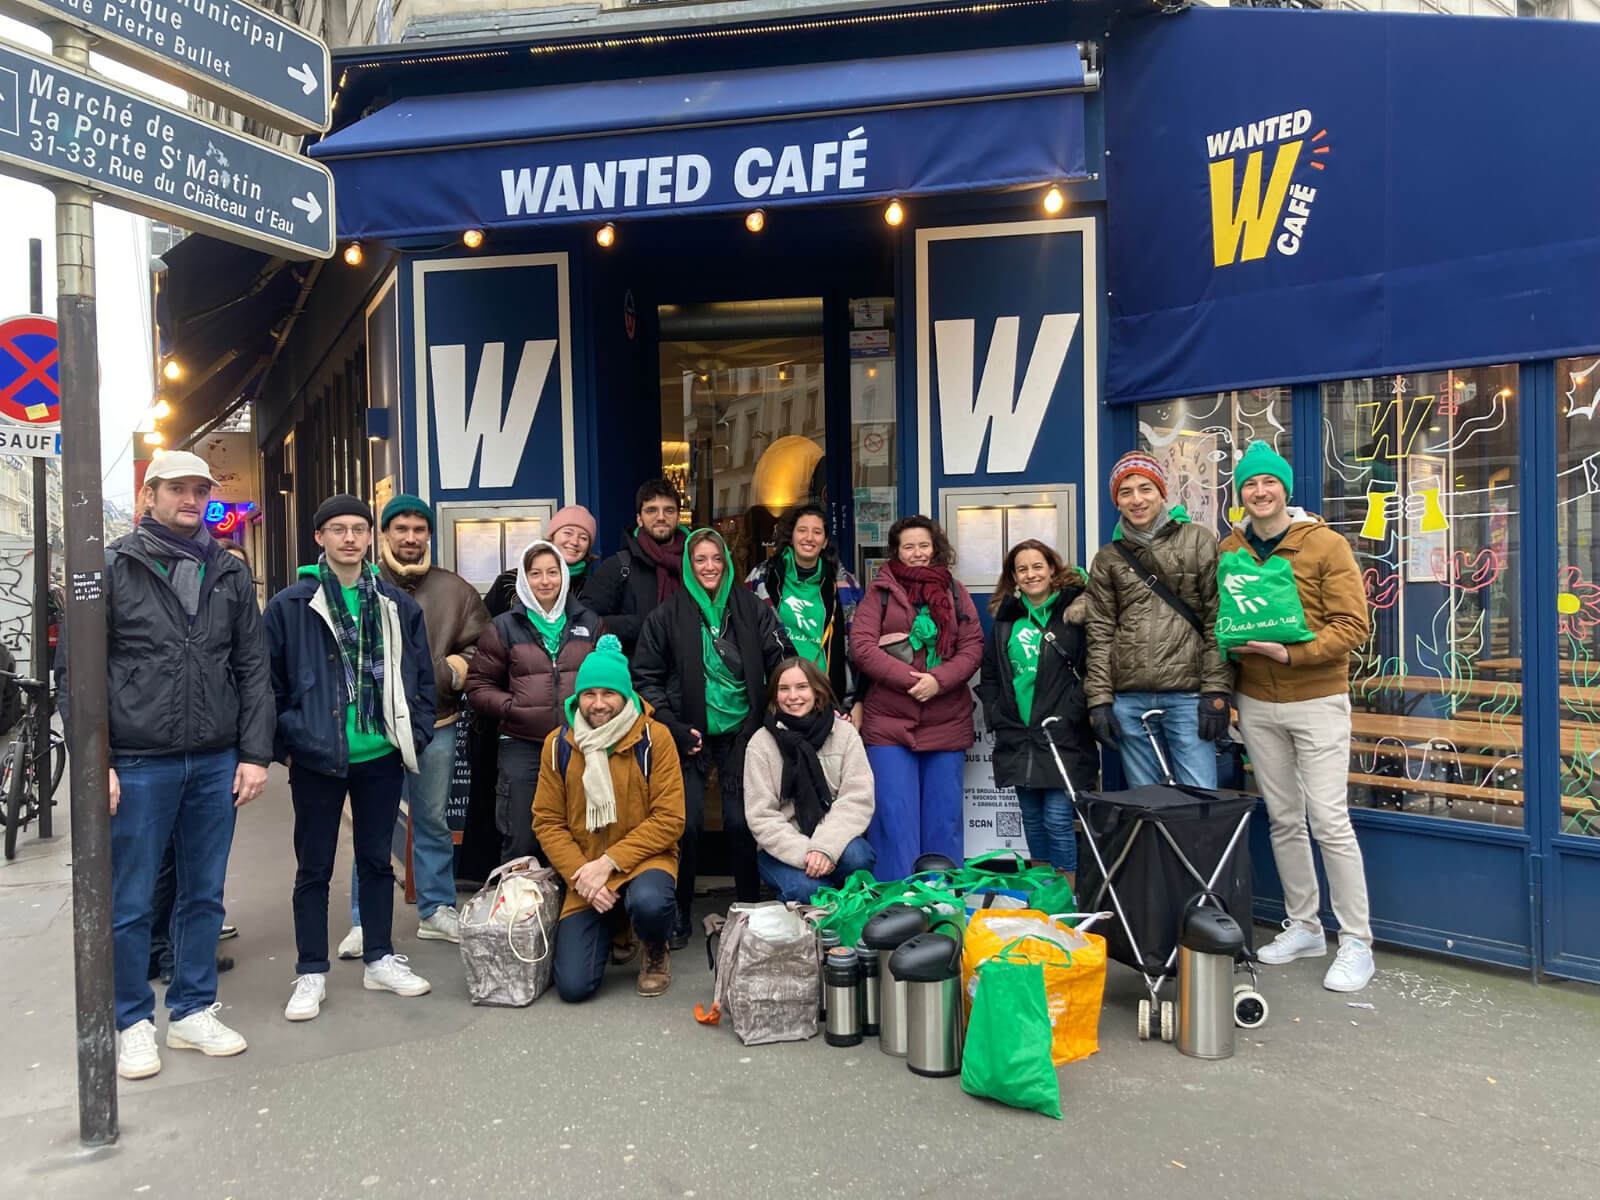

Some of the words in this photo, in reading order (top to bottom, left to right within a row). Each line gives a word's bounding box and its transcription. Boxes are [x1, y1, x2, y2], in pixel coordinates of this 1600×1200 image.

[59, 0, 93, 14] ue
[103, 3, 165, 46] Pierre
[174, 35, 231, 77] Bullet
[28, 69, 133, 127] Marché
[146, 115, 175, 142] de
[28, 98, 60, 132] La
[74, 114, 146, 160] Porte
[1206, 109, 1312, 158] WANTED
[109, 156, 144, 184] Rue
[154, 173, 176, 195] du
[183, 182, 247, 218] Château
[255, 207, 294, 235] d'Eau
[500, 153, 712, 216] WANTED
[734, 126, 868, 199] CAFÉ
[1209, 139, 1304, 267] W
[1276, 183, 1317, 255] CAFÉ
[429, 339, 557, 489] W
[934, 312, 1080, 475] W
[0, 432, 51, 450] SAUF
[1216, 616, 1255, 634] Dans
[1256, 619, 1278, 628] ma
[1280, 616, 1298, 625] rue
[968, 819, 993, 828] SCAN
